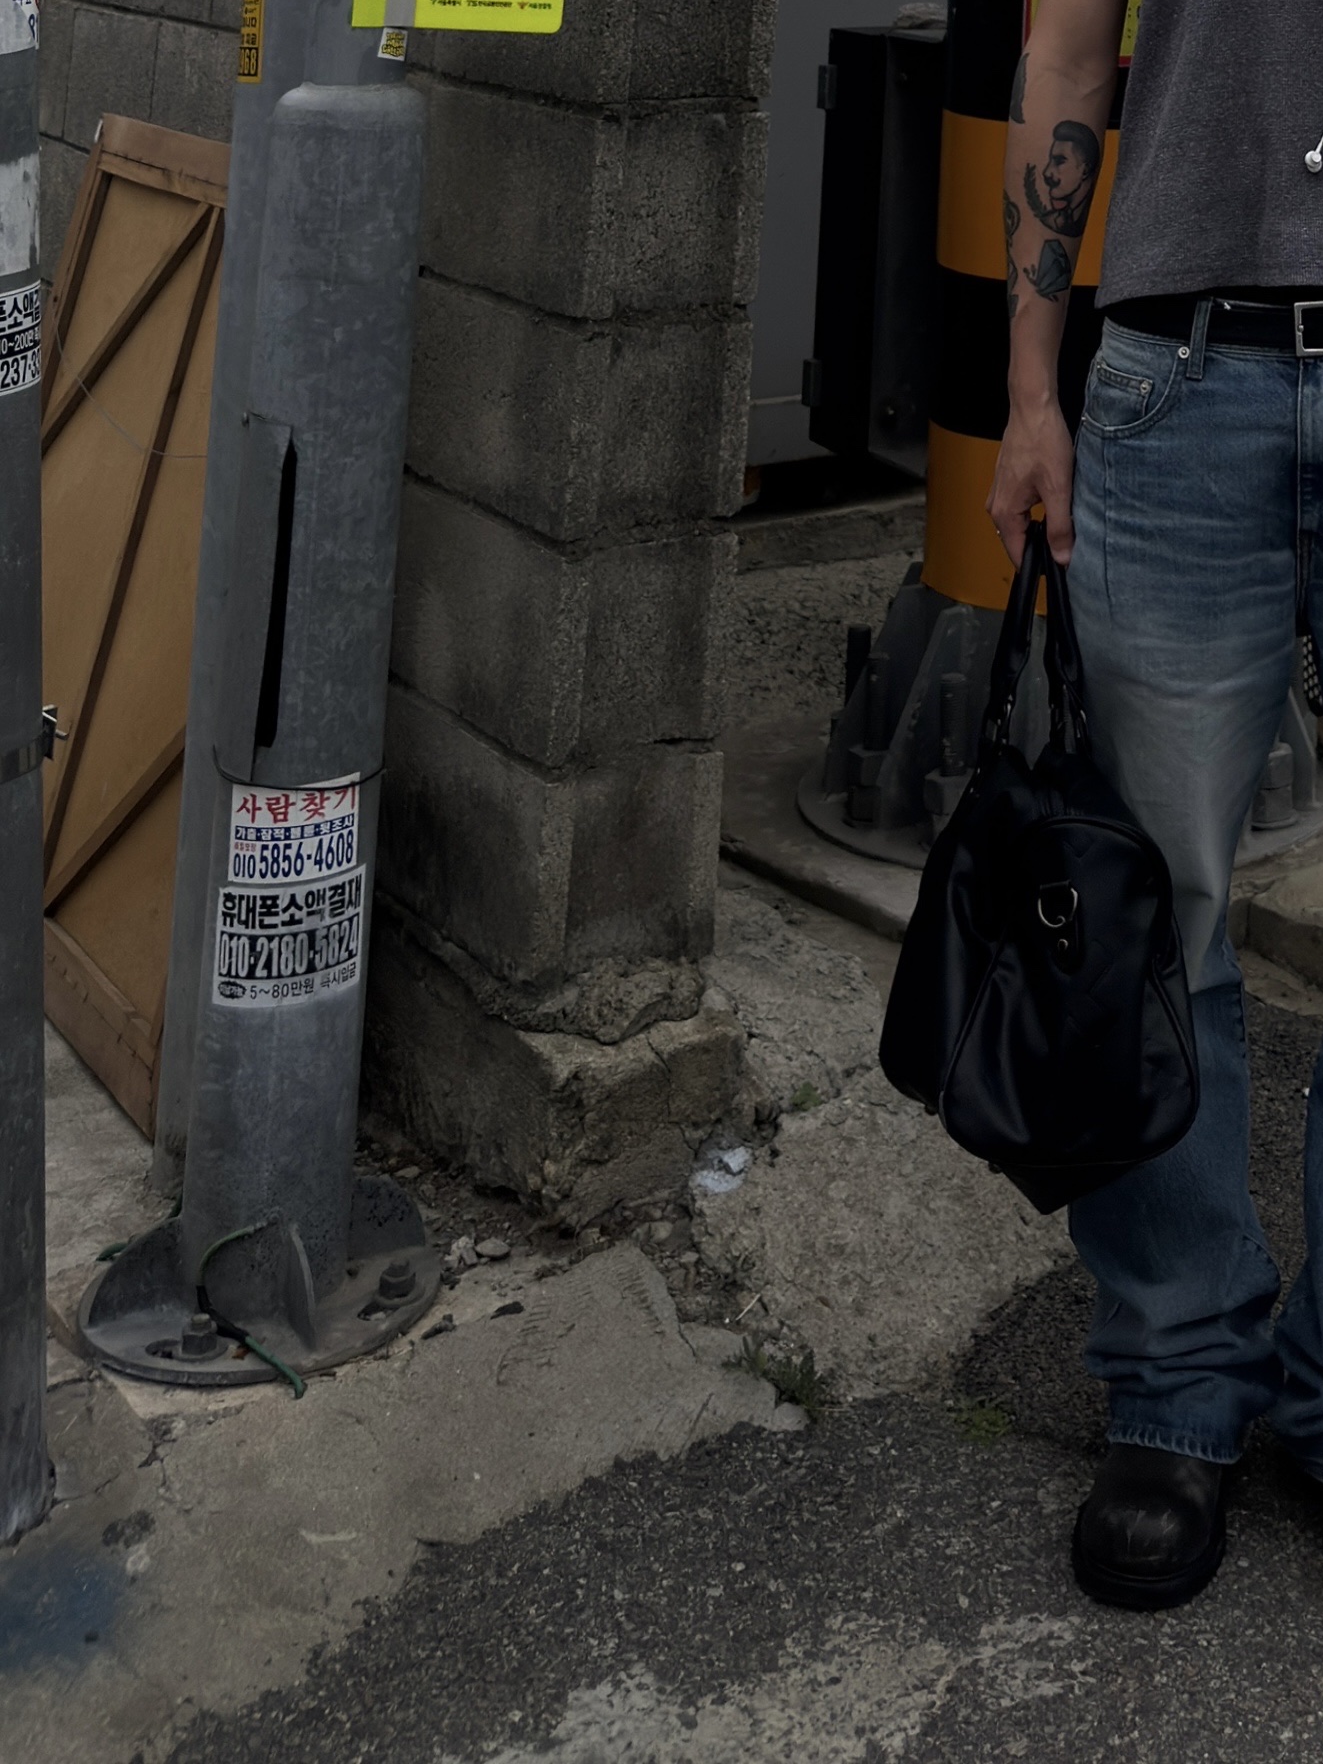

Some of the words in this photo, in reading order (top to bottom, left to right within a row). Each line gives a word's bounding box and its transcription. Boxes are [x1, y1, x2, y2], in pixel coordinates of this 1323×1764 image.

[233, 853, 256, 878] 010
[259, 828, 354, 879] 5856-4608
[250, 978, 315, 999] 5~80만원
